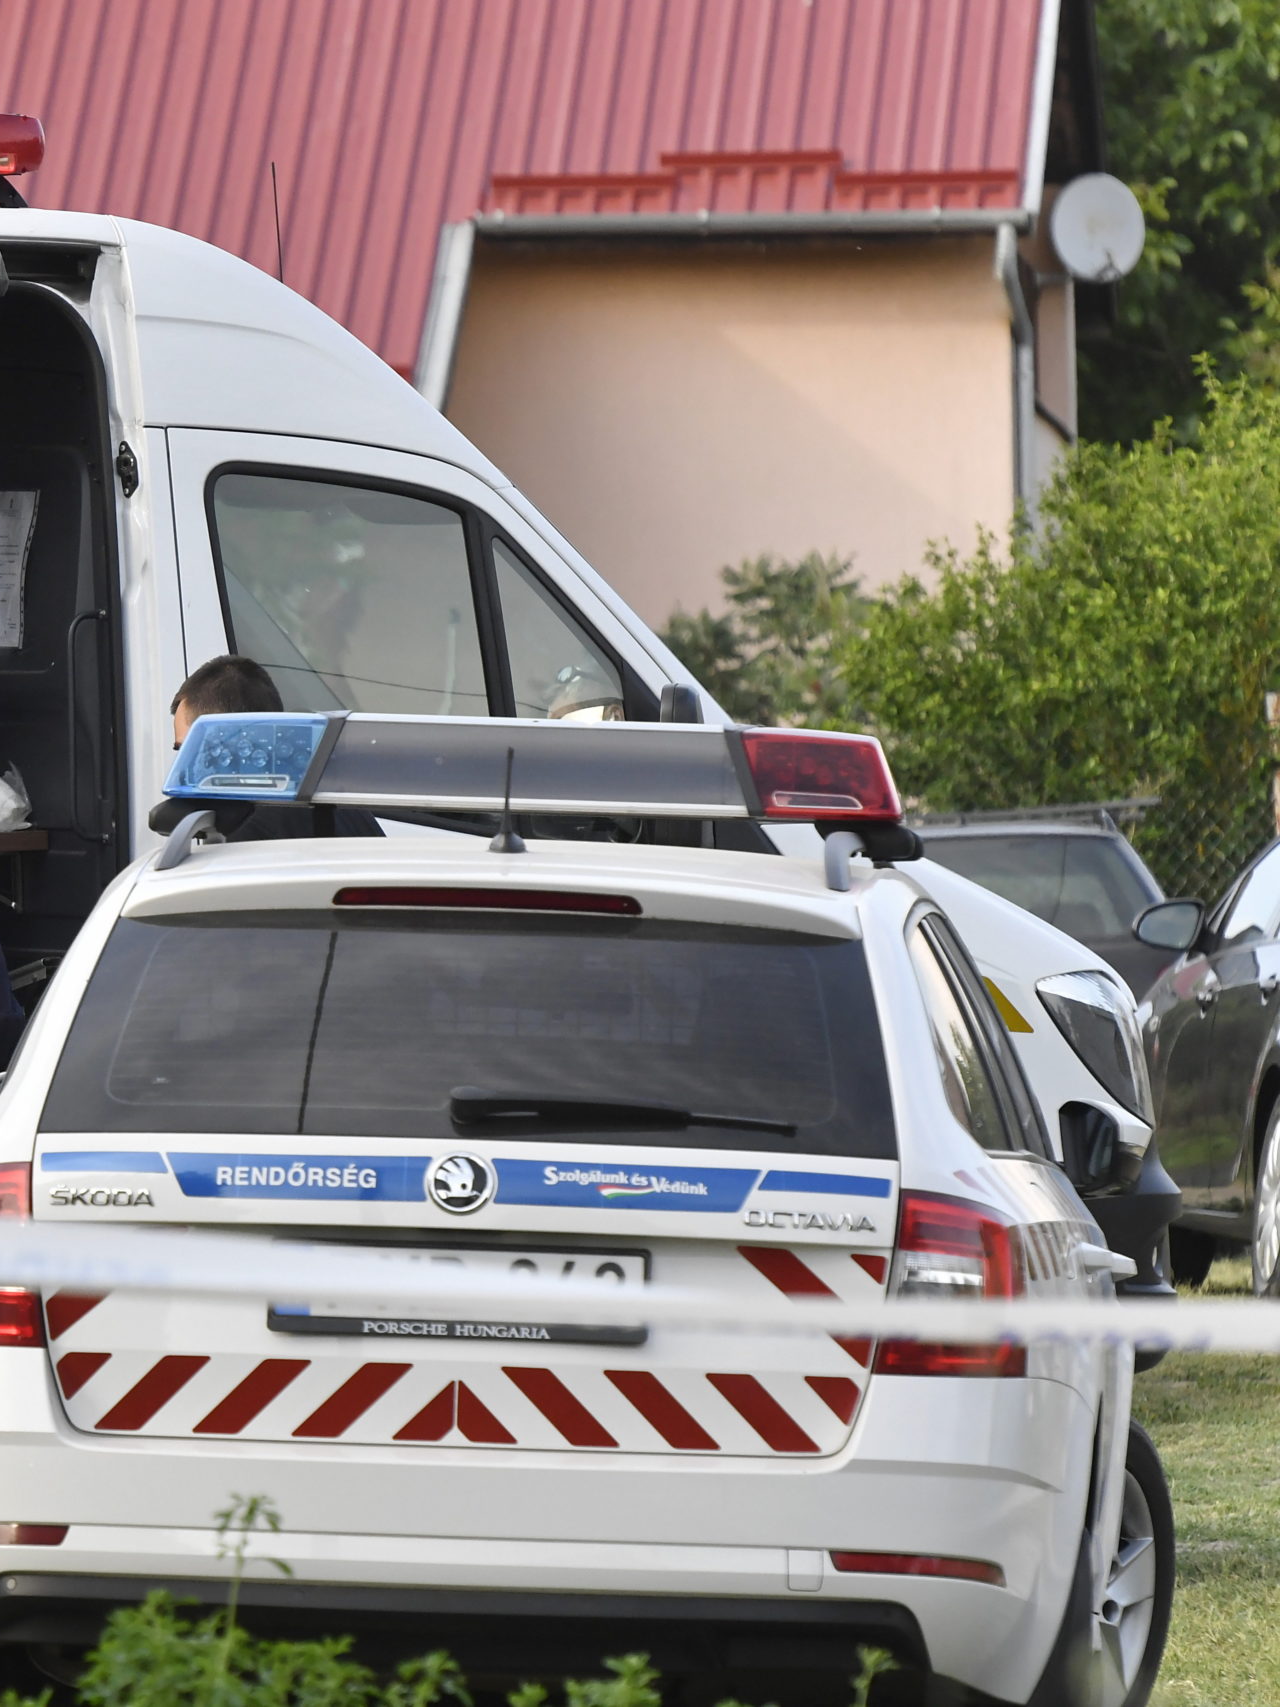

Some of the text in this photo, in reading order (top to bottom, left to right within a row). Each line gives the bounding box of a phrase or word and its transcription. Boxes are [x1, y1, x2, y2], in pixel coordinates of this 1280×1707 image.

[216, 1162, 378, 1189] RENDŐRSÉG
[543, 1166, 708, 1195] Szolgálunk és Védünk
[743, 1208, 877, 1233] OCTAVIA
[362, 1320, 551, 1340] PORSCHE HUNGARIA
